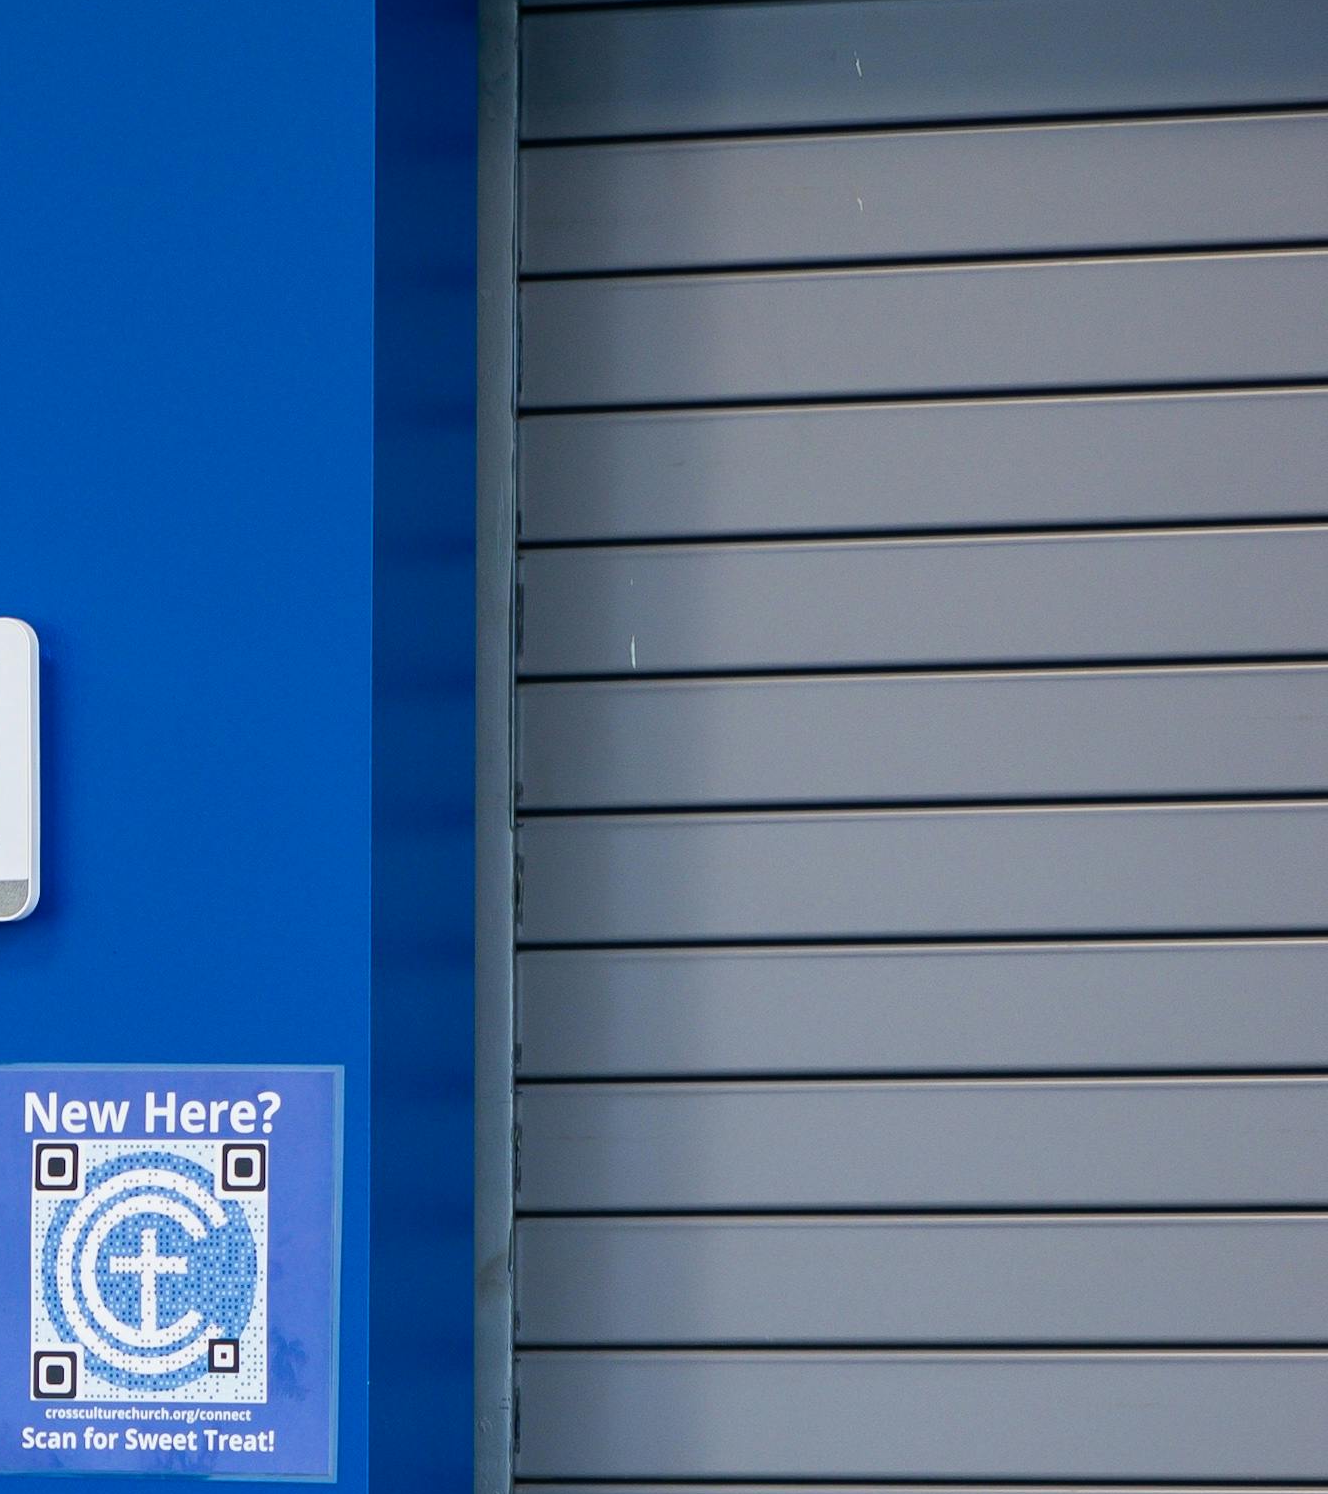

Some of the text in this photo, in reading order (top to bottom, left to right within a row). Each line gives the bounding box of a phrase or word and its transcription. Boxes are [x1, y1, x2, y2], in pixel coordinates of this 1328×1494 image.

[23, 1091, 282, 1134] New Here?
[45, 1406, 252, 1424] crossculturechurch.org/connect
[21, 1426, 275, 1452] Scan for Sweet Treat!
